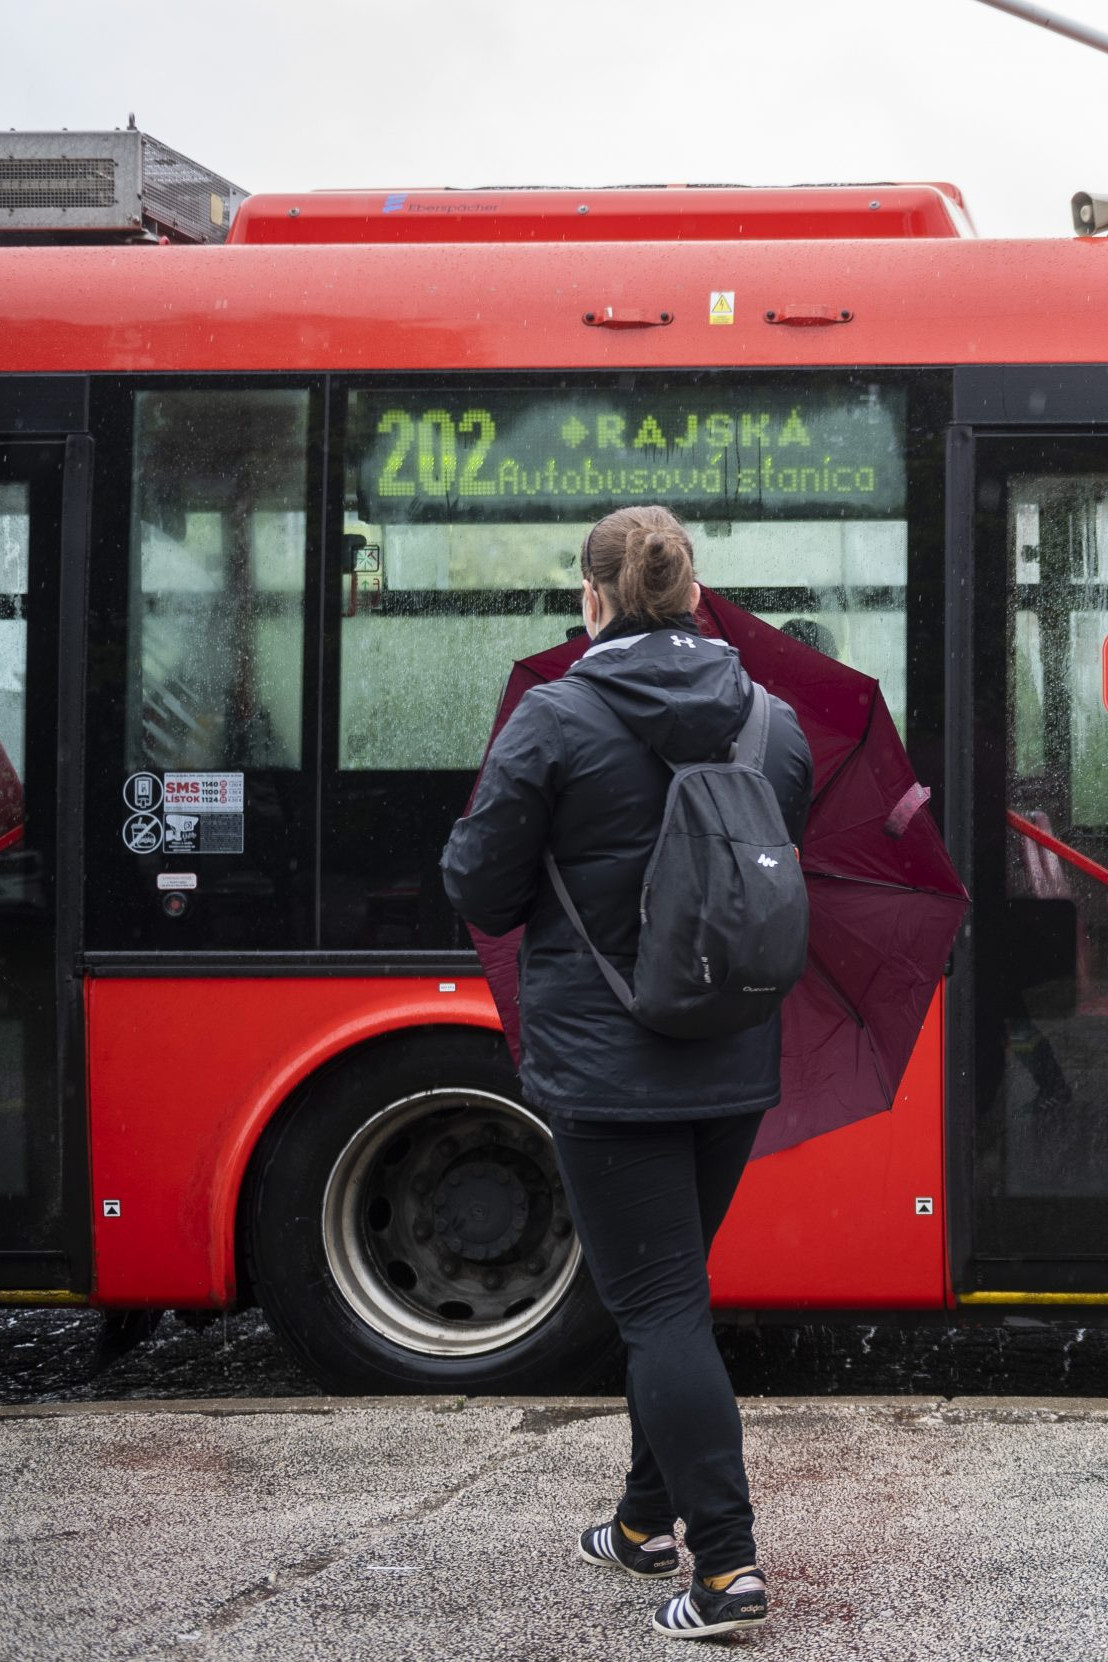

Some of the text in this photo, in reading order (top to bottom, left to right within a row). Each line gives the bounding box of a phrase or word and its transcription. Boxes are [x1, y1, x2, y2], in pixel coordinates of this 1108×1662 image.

[597, 405, 811, 448] RAJSKÁ
[377, 408, 496, 497] 202
[498, 453, 876, 496] Autobusová stanica
[165, 795, 200, 803] LÍSTOK
[166, 782, 200, 794] SMS
[740, 1604, 765, 1614] adidas
